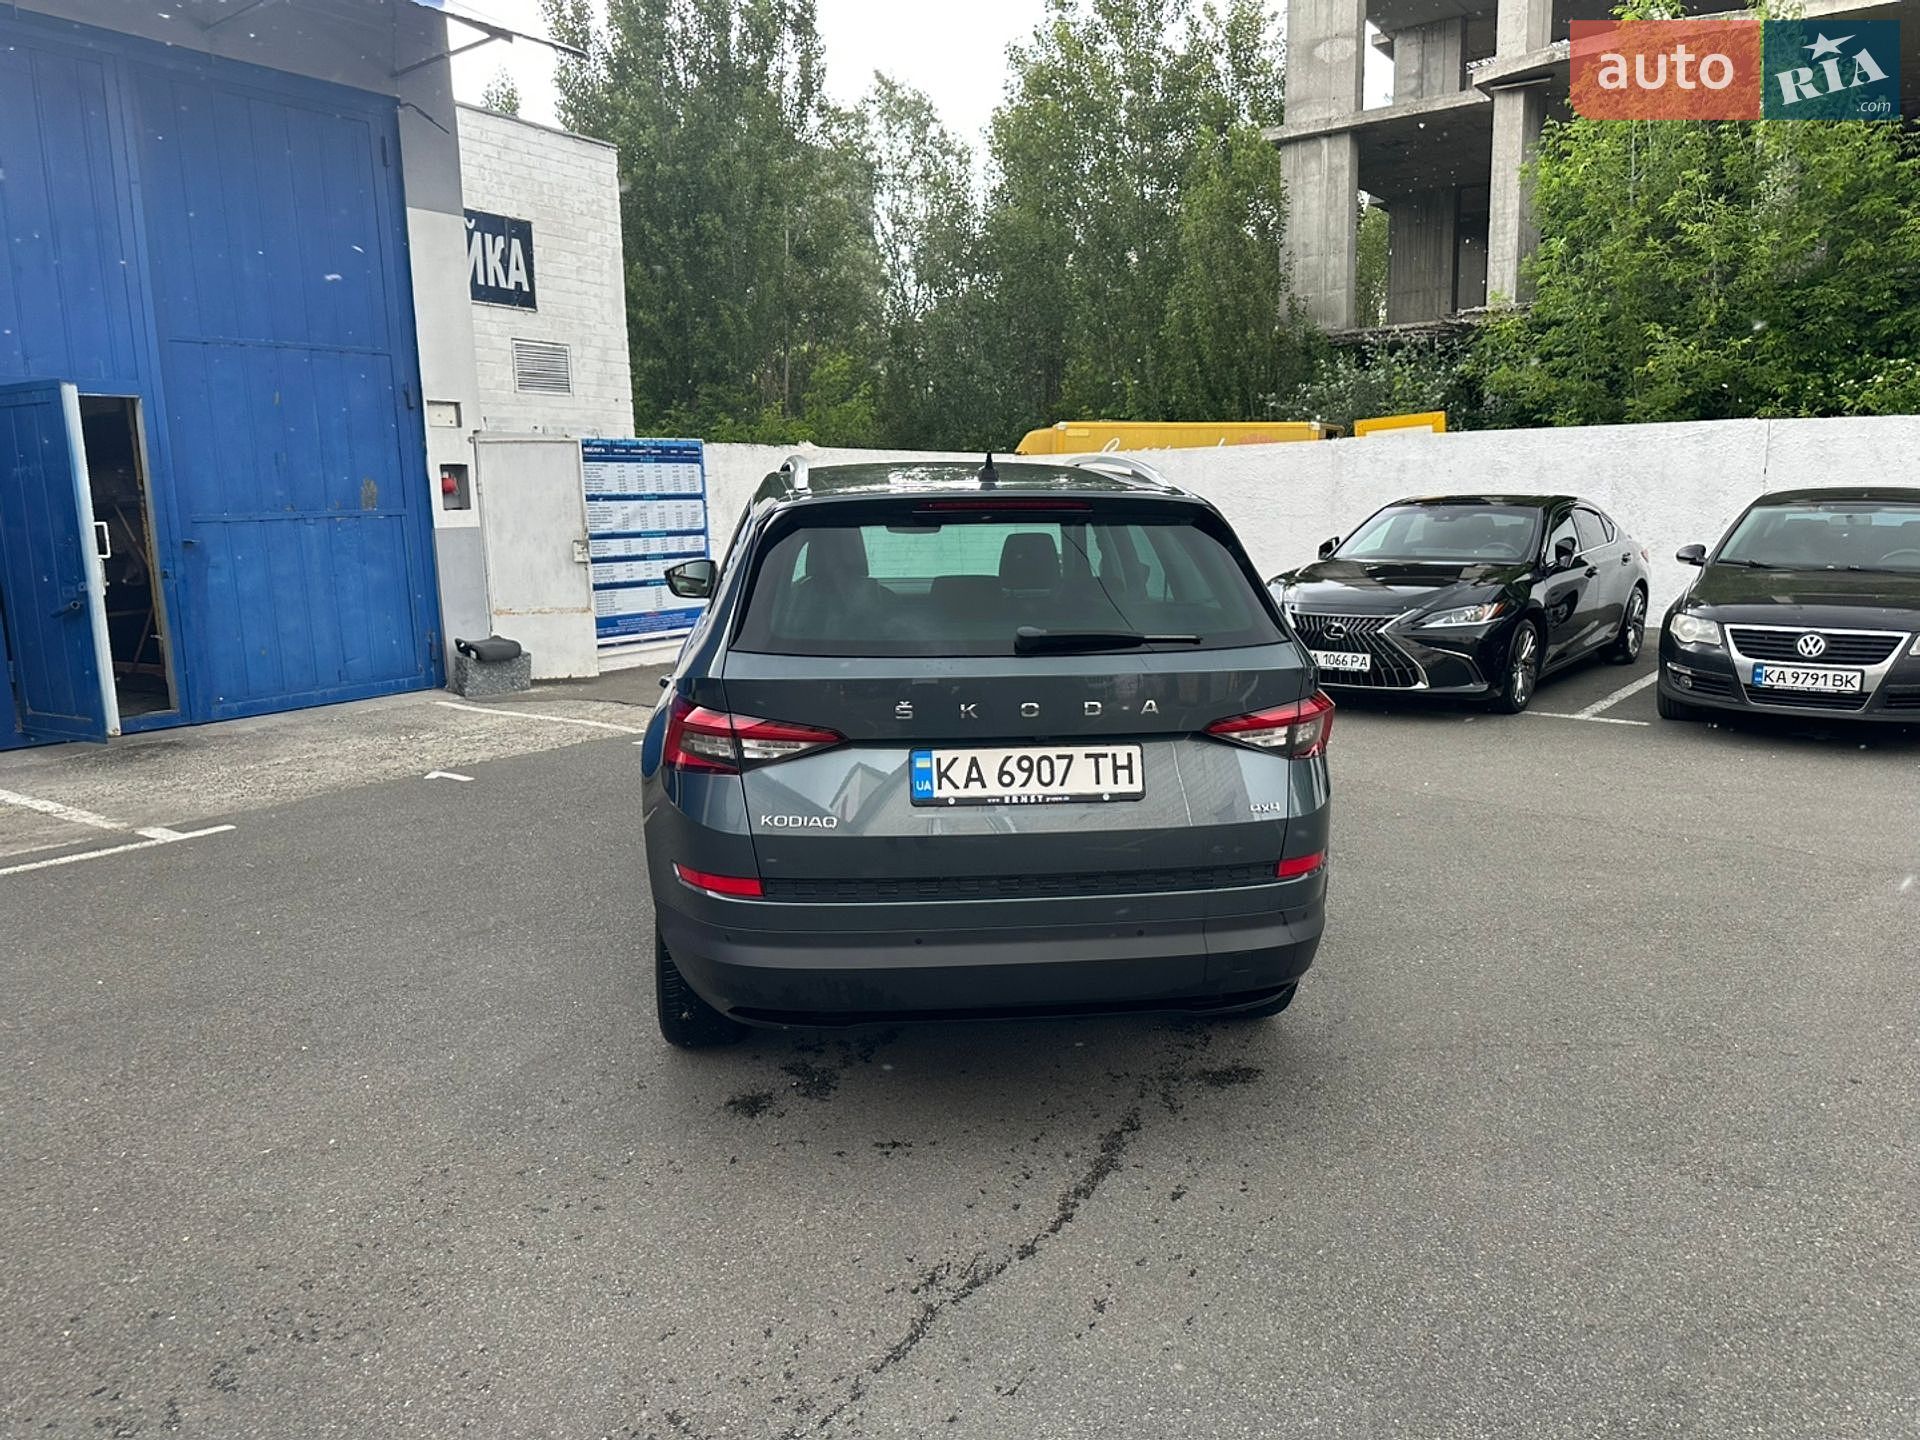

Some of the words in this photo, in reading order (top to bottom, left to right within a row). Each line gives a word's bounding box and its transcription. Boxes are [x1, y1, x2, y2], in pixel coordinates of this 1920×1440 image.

[1323, 653, 1348, 666] 1066
[1350, 655, 1368, 668] PA
[1764, 669, 1787, 684] KA
[1791, 671, 1828, 686] 9791
[1832, 674, 1857, 688] BK
[895, 700, 1159, 719] ŠKODA
[936, 757, 987, 790] KA
[997, 754, 1073, 787] 6907
[1084, 752, 1134, 785] TH
[916, 780, 931, 791] UA
[761, 815, 838, 829] KODIAQ
